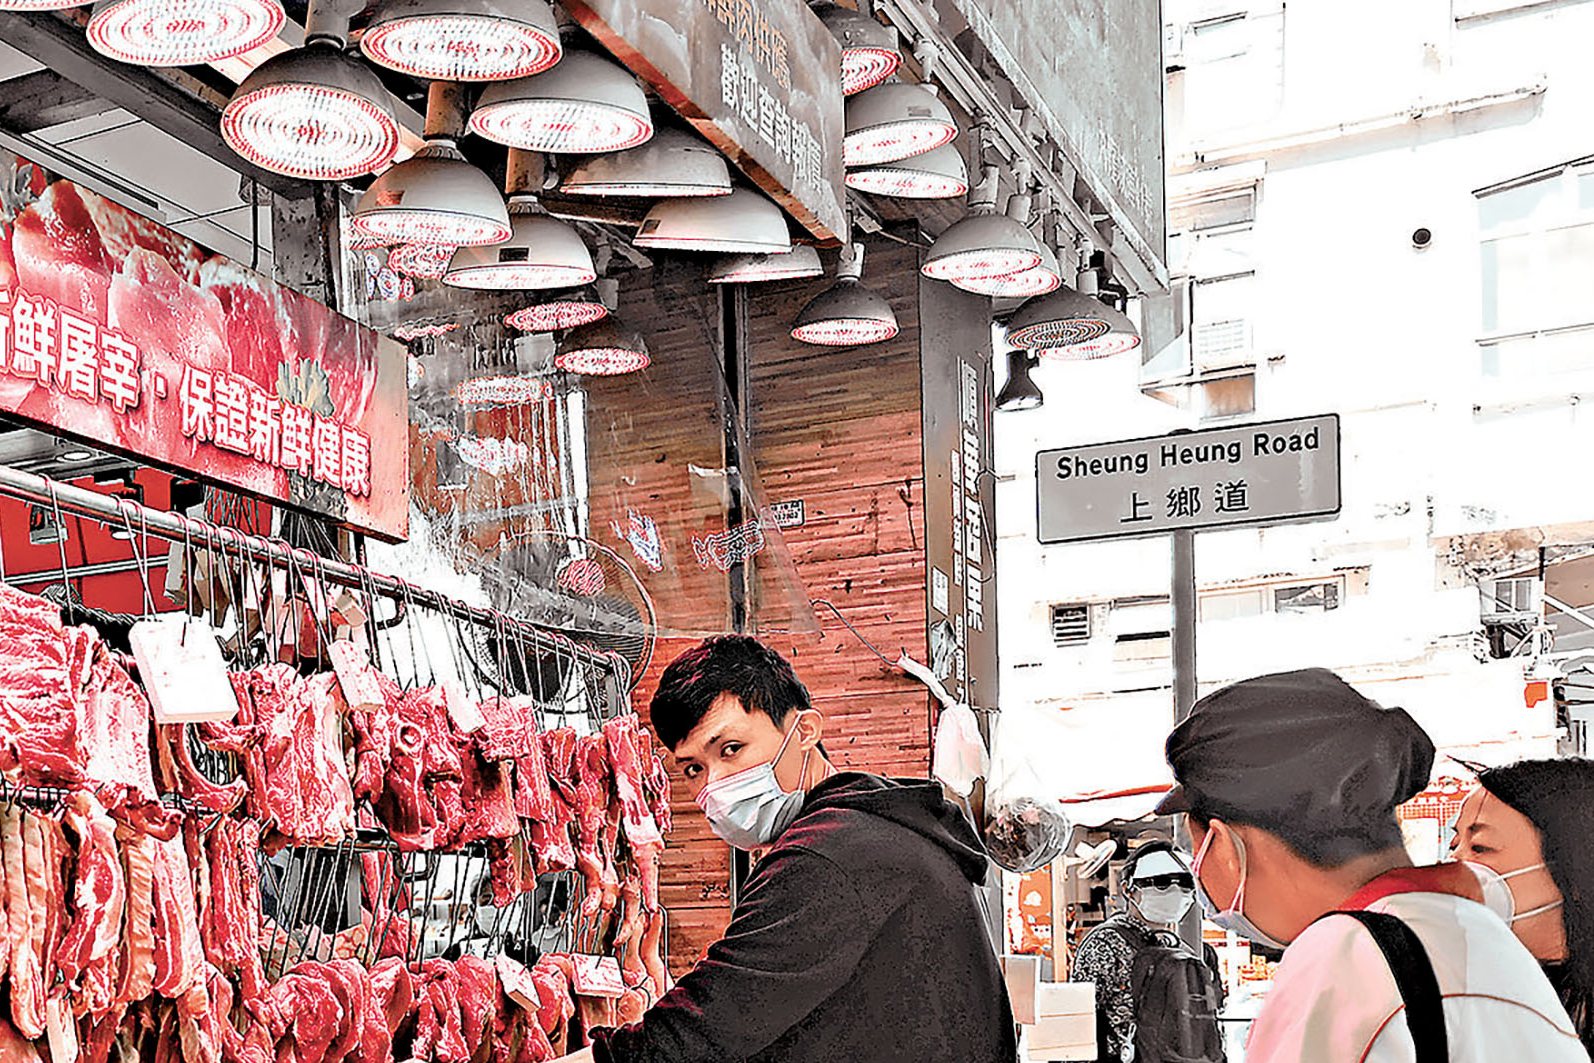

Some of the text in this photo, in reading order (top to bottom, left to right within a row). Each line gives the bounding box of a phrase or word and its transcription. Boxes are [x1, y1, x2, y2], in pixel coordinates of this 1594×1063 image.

[1056, 427, 1320, 480] Sheung Heung Road
[1120, 479, 1250, 524] 上鄉道
